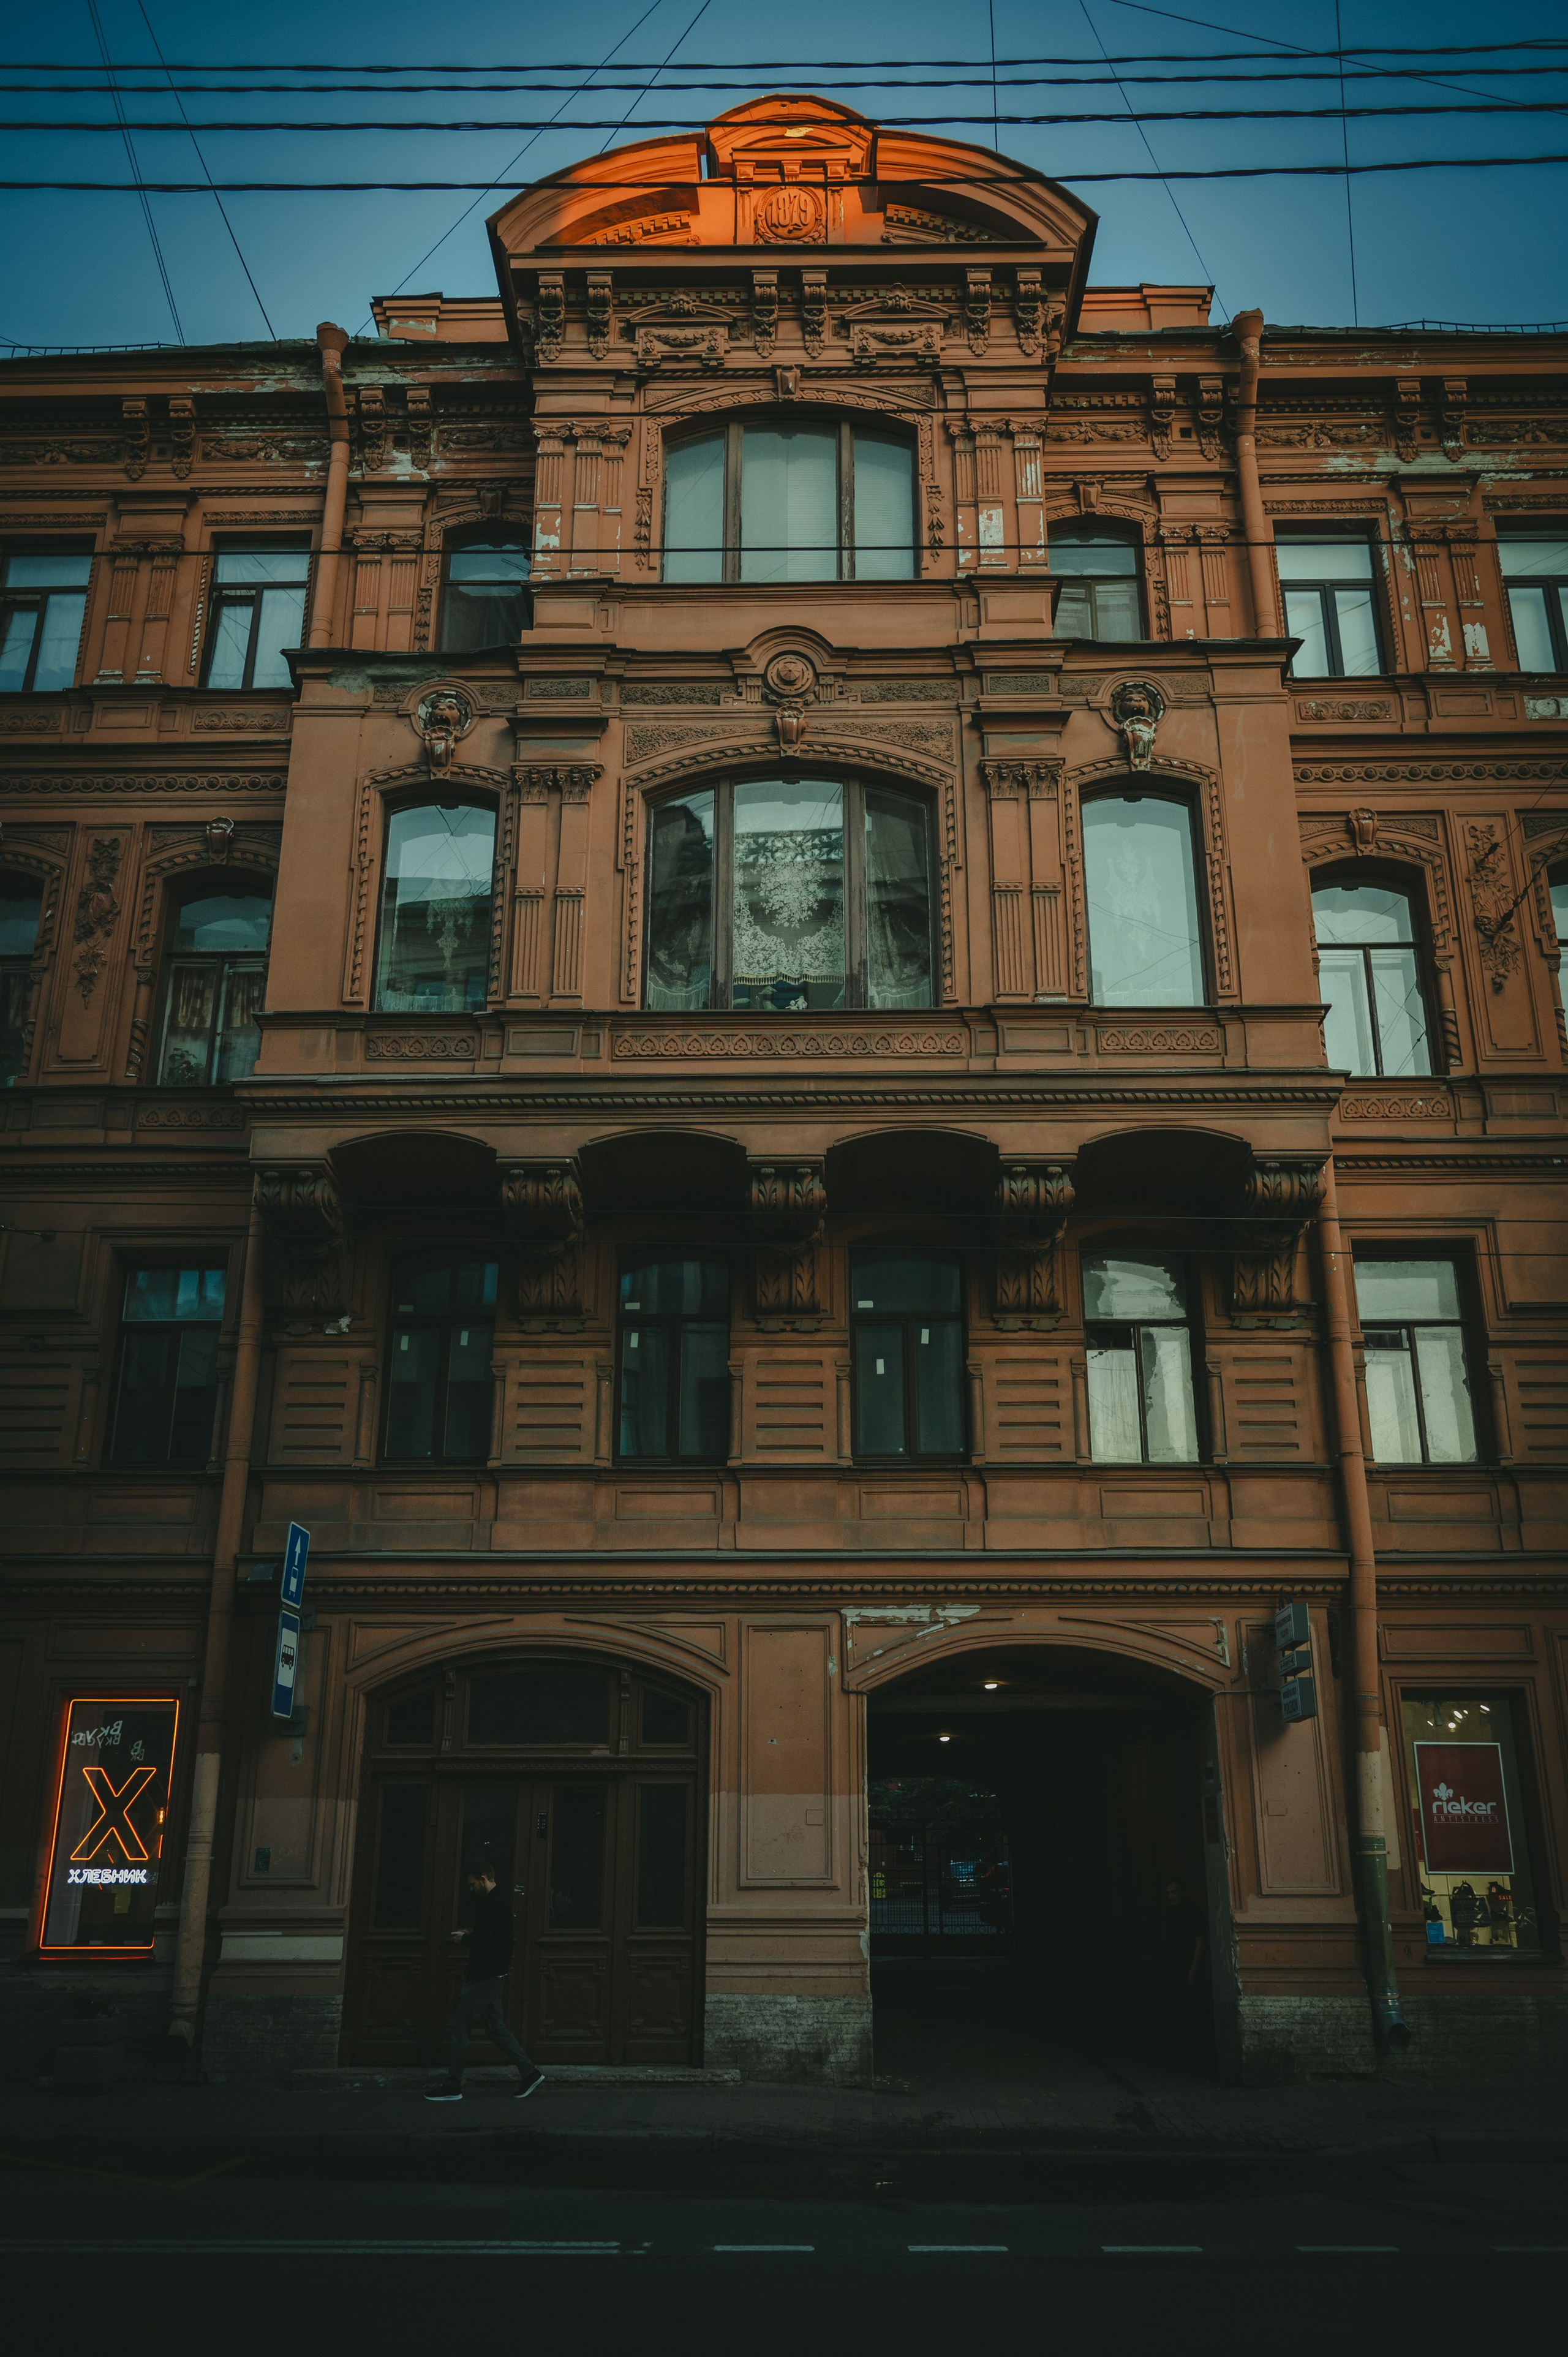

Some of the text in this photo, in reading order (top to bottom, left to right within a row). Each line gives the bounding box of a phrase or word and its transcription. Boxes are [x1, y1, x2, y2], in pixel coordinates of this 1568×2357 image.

[768, 192, 811, 230] 1879
[1432, 1796, 1496, 1815] rieker
[67, 1868, 148, 1884] ХЛЕБНИК
